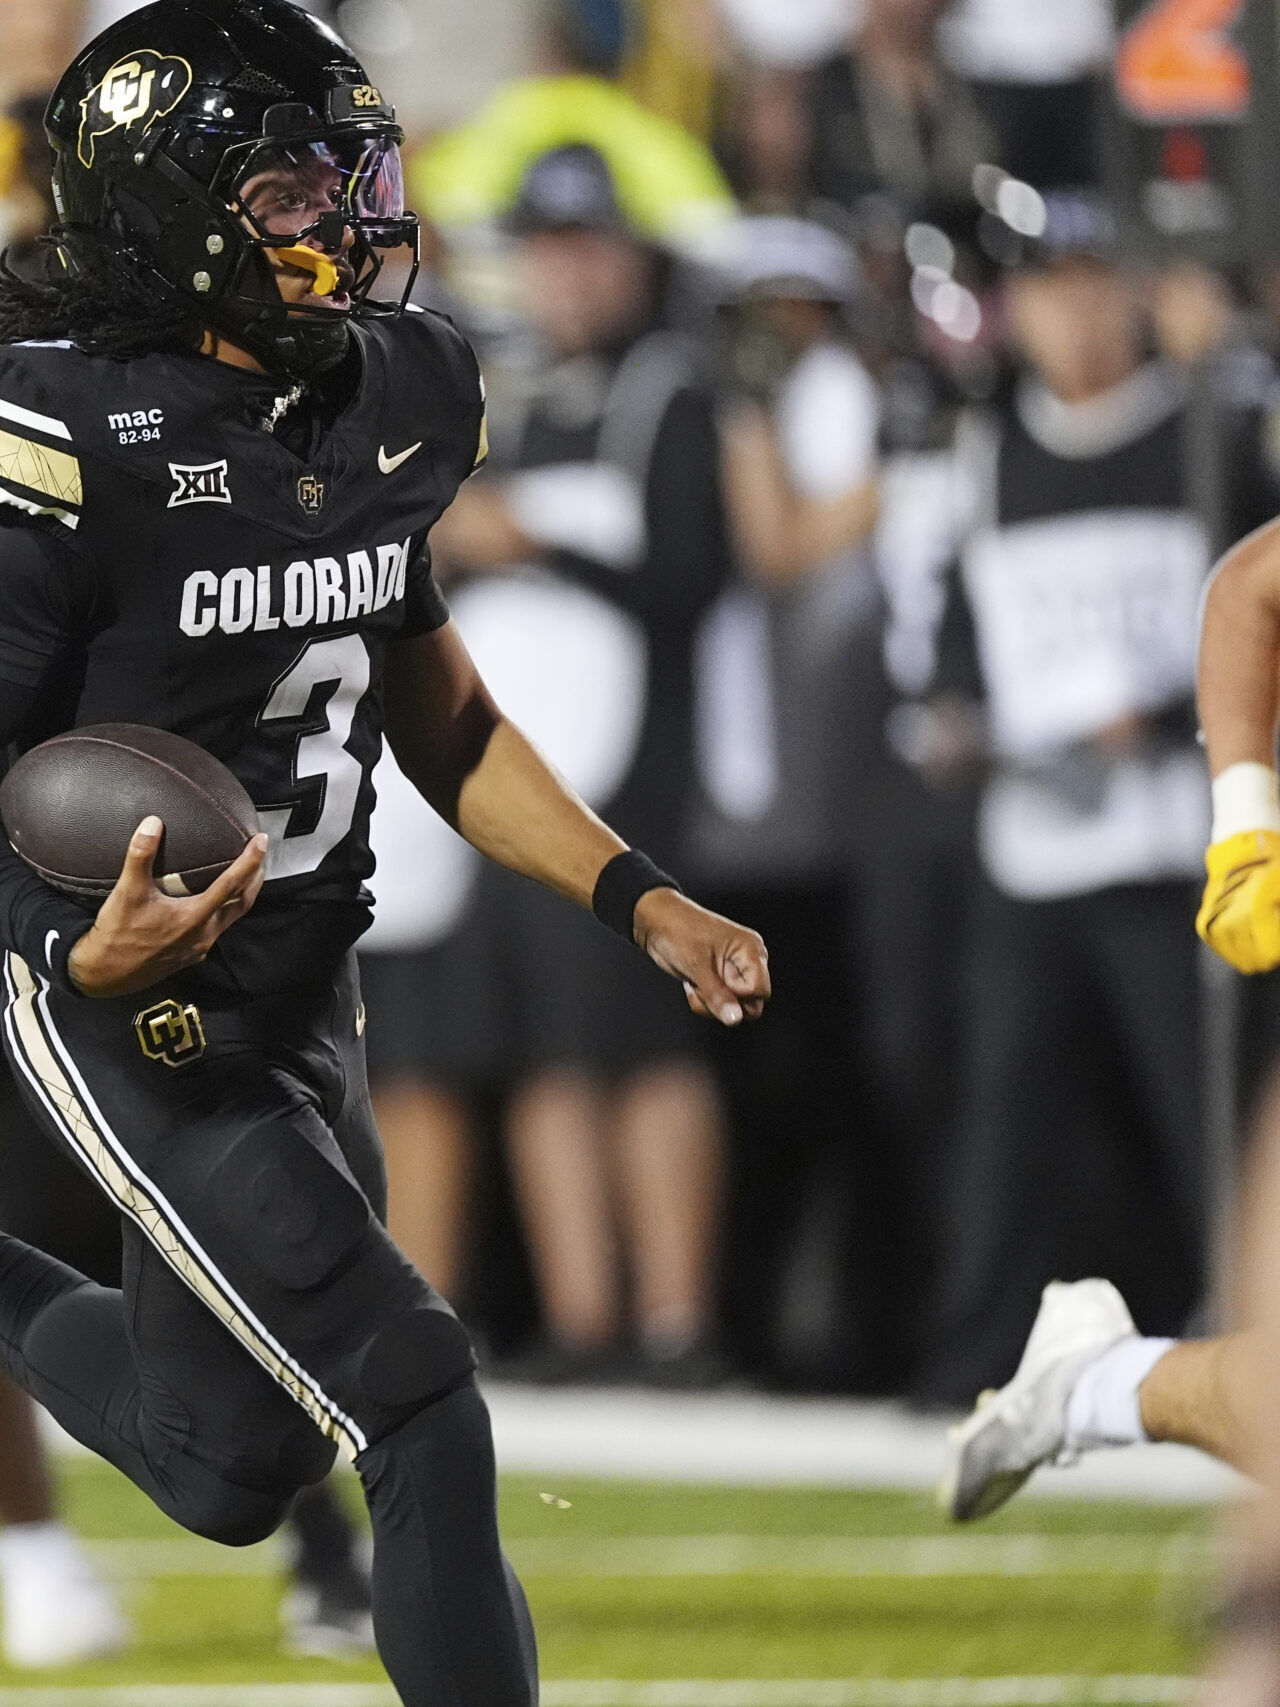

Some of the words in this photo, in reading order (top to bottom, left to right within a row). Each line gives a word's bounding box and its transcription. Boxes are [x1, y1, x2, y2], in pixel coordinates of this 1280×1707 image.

[107, 408, 165, 430] mac
[118, 427, 162, 445] 82-94
[255, 630, 371, 882] 3
